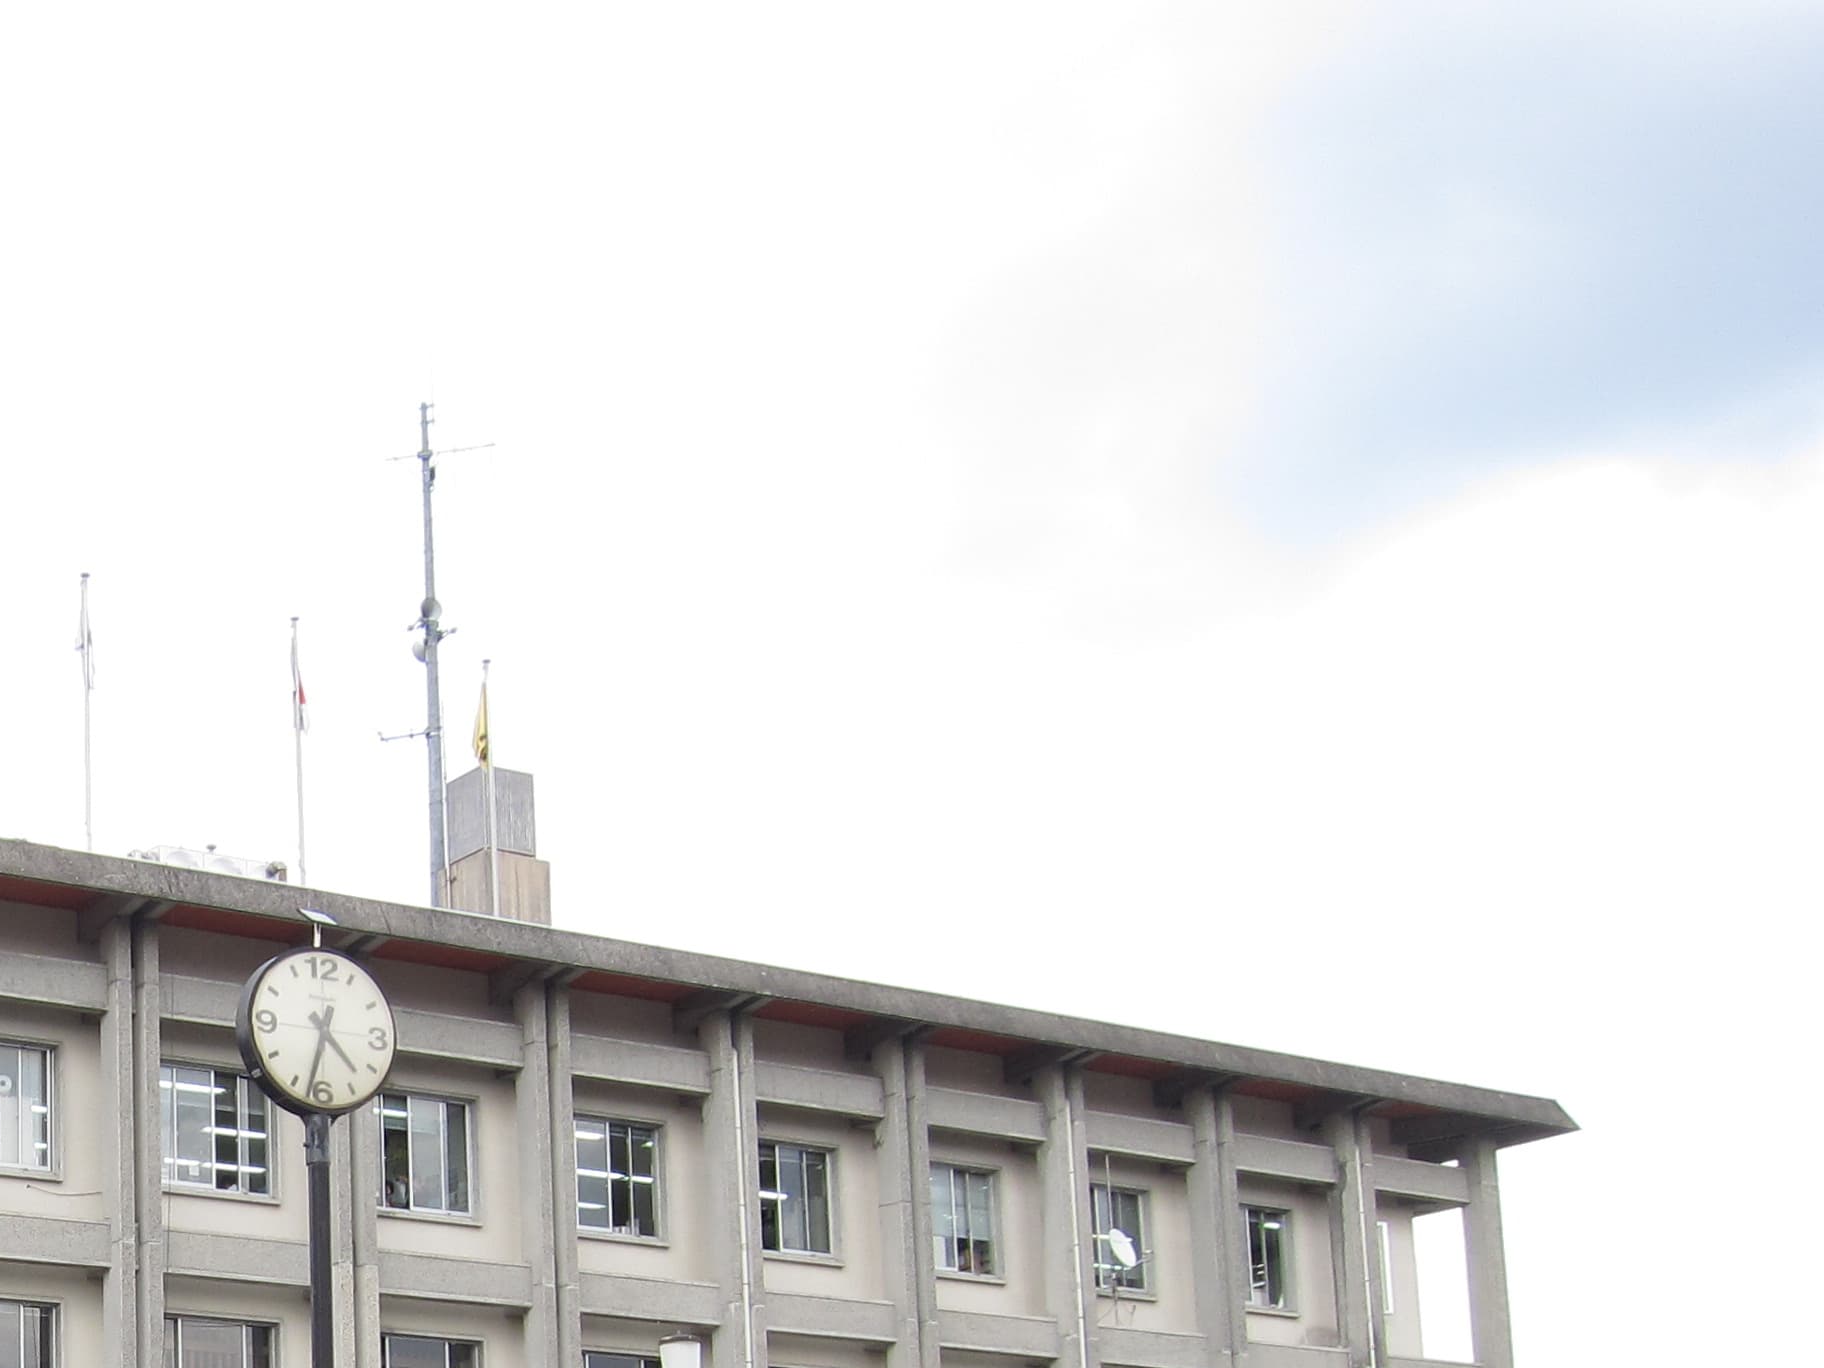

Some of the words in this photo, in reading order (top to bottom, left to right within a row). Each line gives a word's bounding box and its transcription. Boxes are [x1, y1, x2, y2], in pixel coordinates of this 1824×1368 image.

[304, 956, 339, 982] 12
[256, 1009, 278, 1034] 9
[367, 1027, 388, 1051] 3
[312, 1081, 334, 1105] 6
